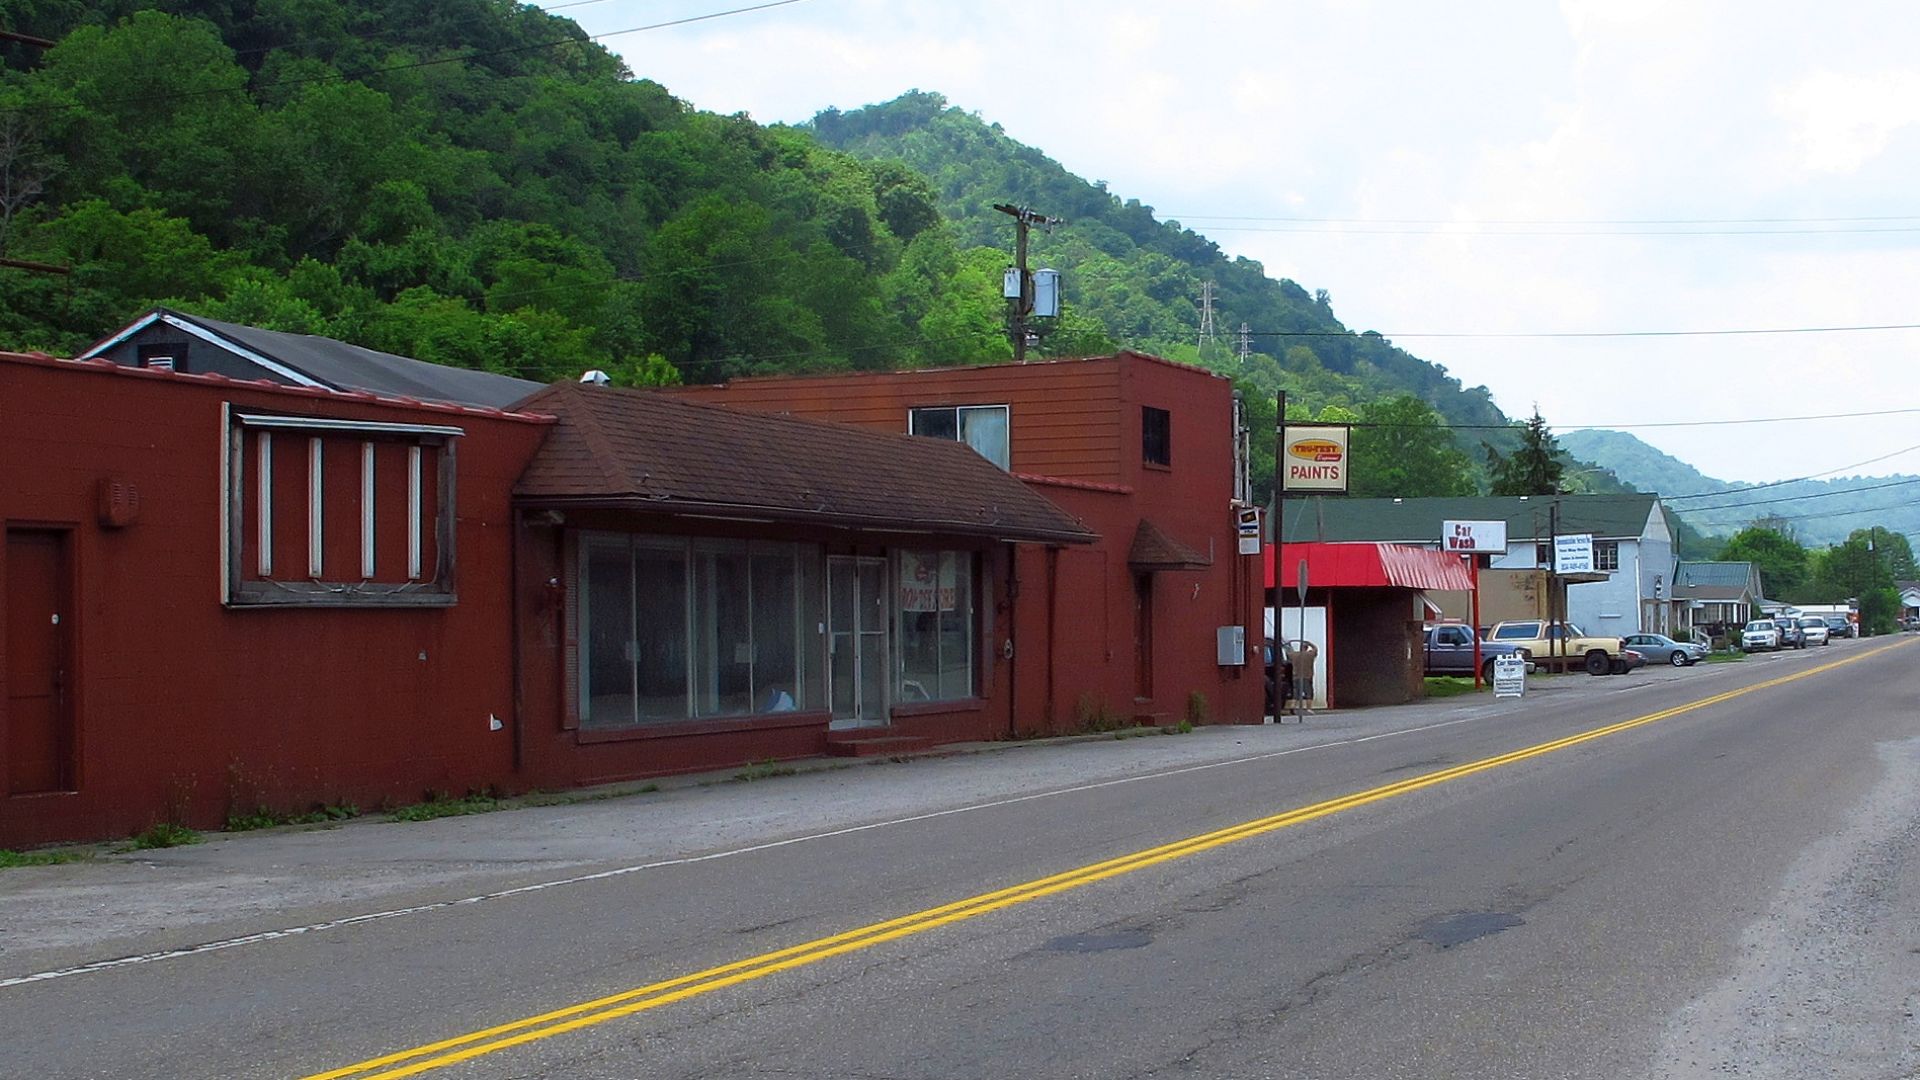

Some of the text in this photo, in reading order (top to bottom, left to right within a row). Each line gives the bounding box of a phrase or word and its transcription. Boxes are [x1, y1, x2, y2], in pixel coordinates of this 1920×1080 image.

[1291, 466, 1339, 479] PAINTS
[1455, 524, 1471, 536] Car
[1448, 537, 1475, 549] Wash
